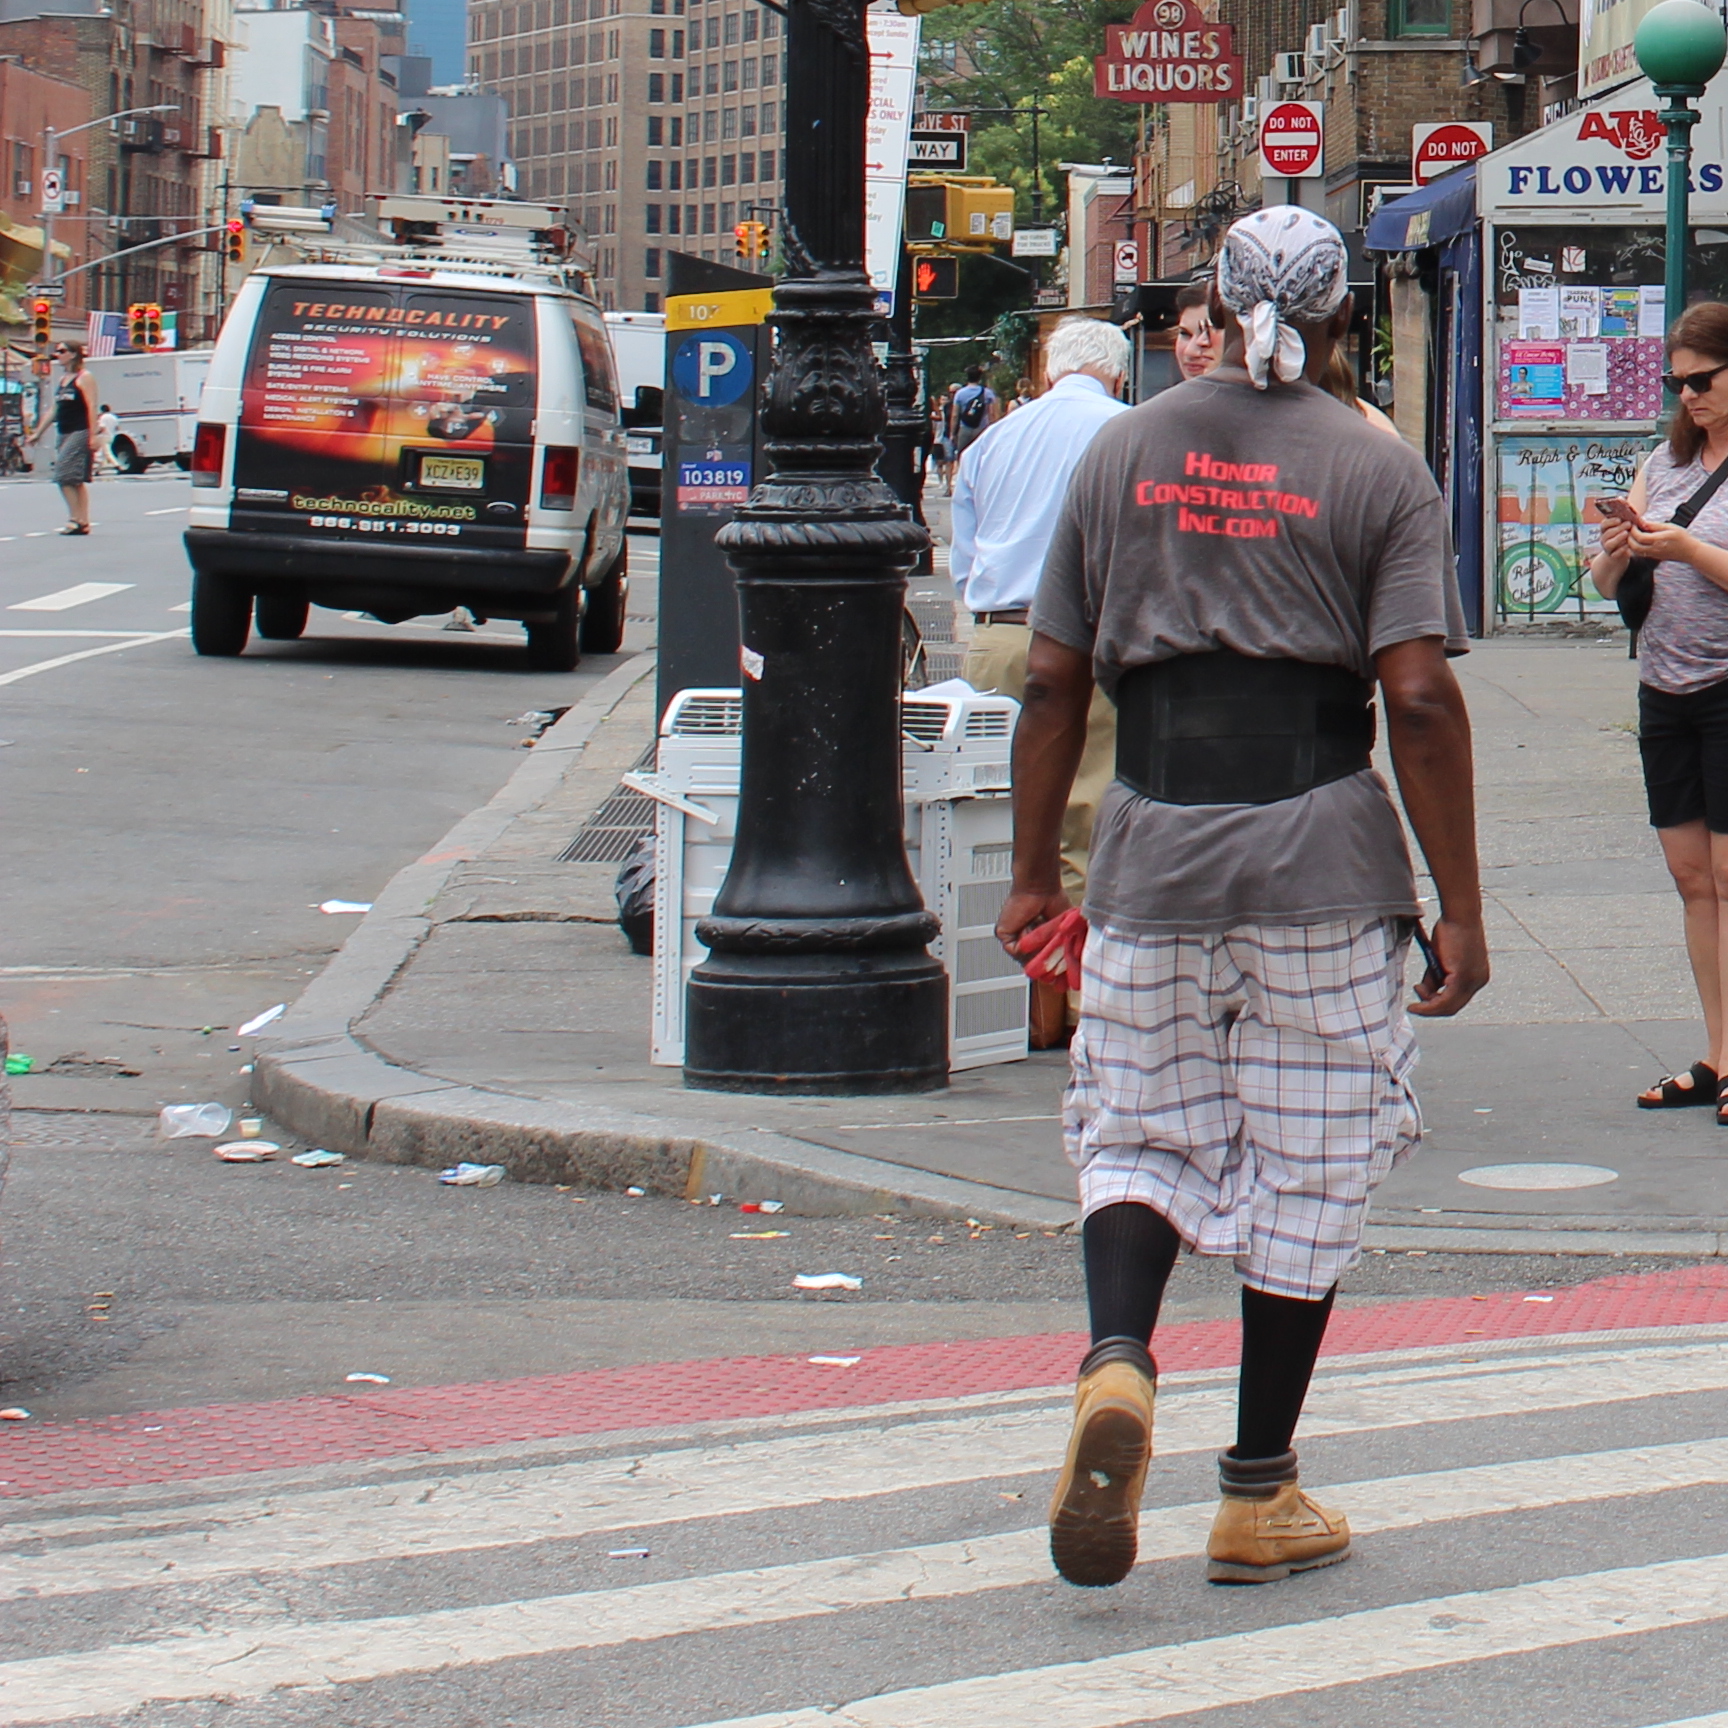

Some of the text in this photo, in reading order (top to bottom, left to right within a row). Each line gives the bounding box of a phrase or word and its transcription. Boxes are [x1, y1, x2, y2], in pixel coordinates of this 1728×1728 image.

[1157, 4, 1180, 23] 98
[1119, 31, 1220, 59] WINES
[1108, 63, 1232, 92] LIQUORS
[881, 110, 904, 121] ONLY
[951, 115, 967, 131] ST
[1269, 116, 1313, 130] DO NOT
[915, 143, 951, 159] WAY
[1273, 149, 1309, 162] ENTER
[1428, 141, 1478, 156] DO NOT
[293, 301, 510, 330] TECHNOCALITY
[303, 323, 492, 343] SECURITY SOLUTIONS
[698, 342, 737, 397] P
[1518, 441, 1646, 468] Ralph & Charlie's
[684, 469, 744, 485] 103819
[1185, 451, 1280, 483] HONOR
[293, 494, 477, 520] technocality.net
[1135, 480, 1320, 519] CONSTRUCTION
[1178, 507, 1279, 538] INC.COM
